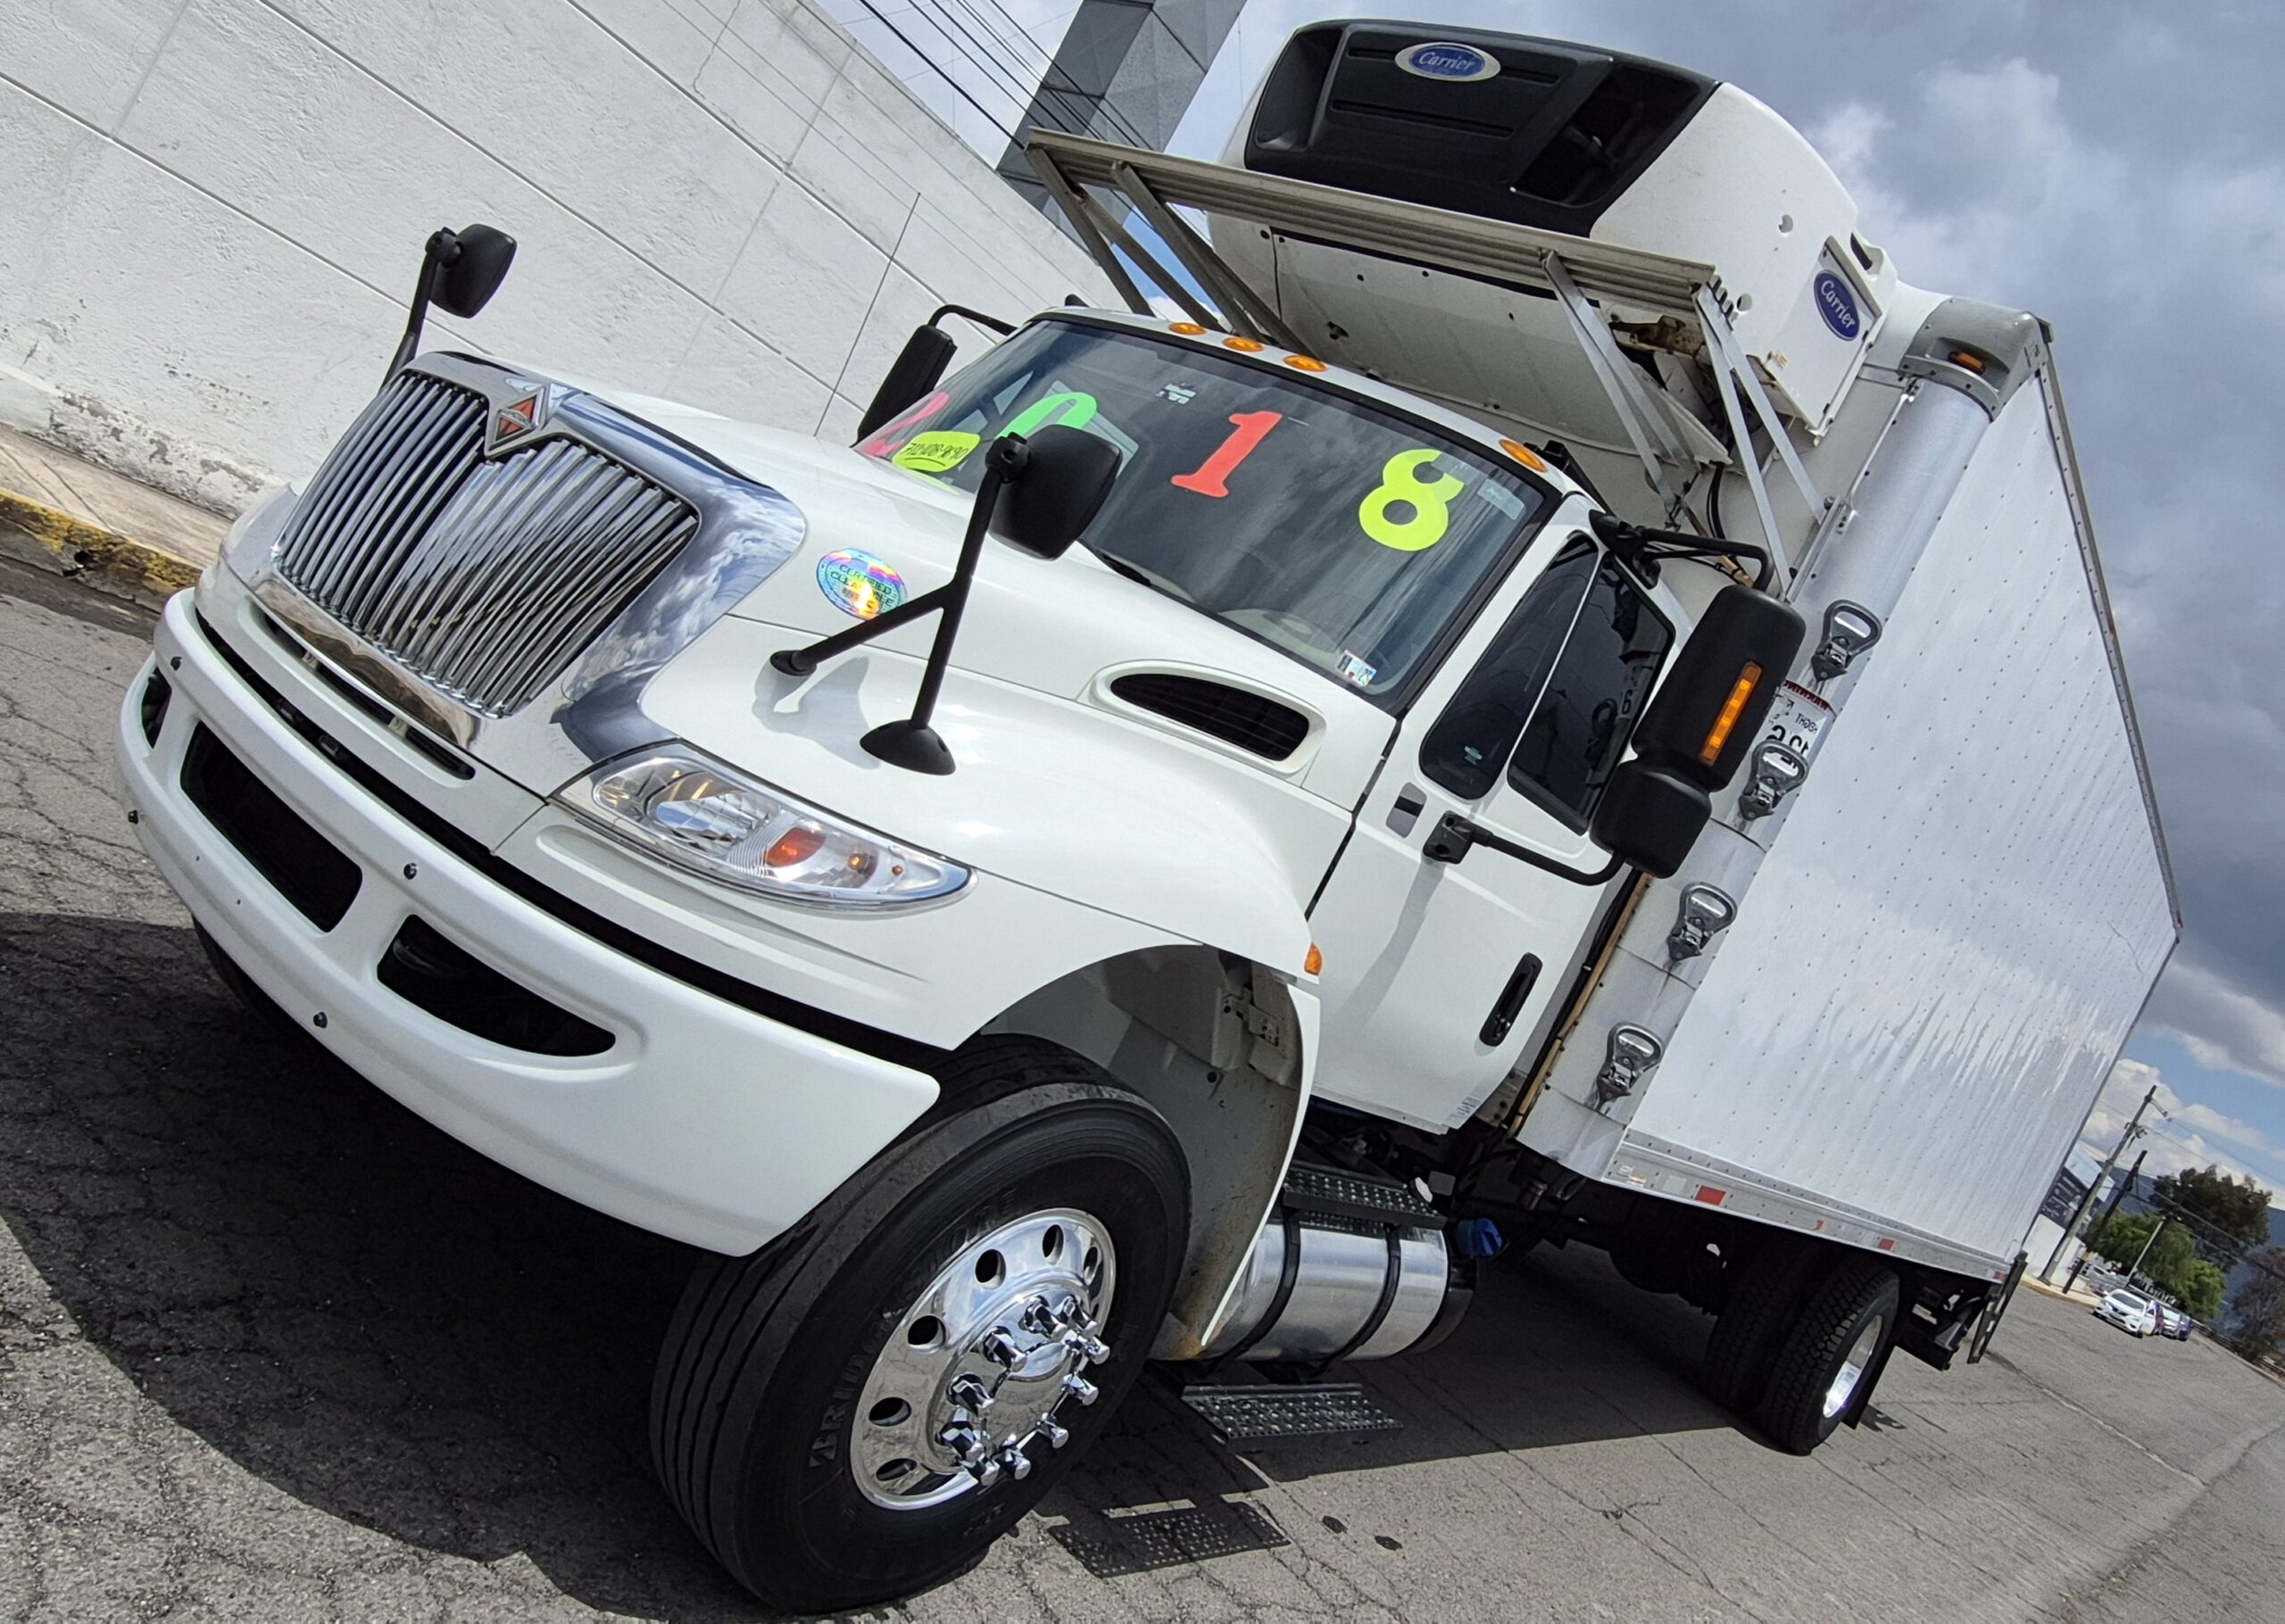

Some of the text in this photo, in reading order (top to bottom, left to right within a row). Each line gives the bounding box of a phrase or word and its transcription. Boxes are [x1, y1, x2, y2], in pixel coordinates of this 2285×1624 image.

[1418, 51, 1476, 71] Carrier
[1821, 279, 1856, 328] Carrier
[1170, 410, 1284, 498] 1
[1359, 448, 1464, 551] 8
